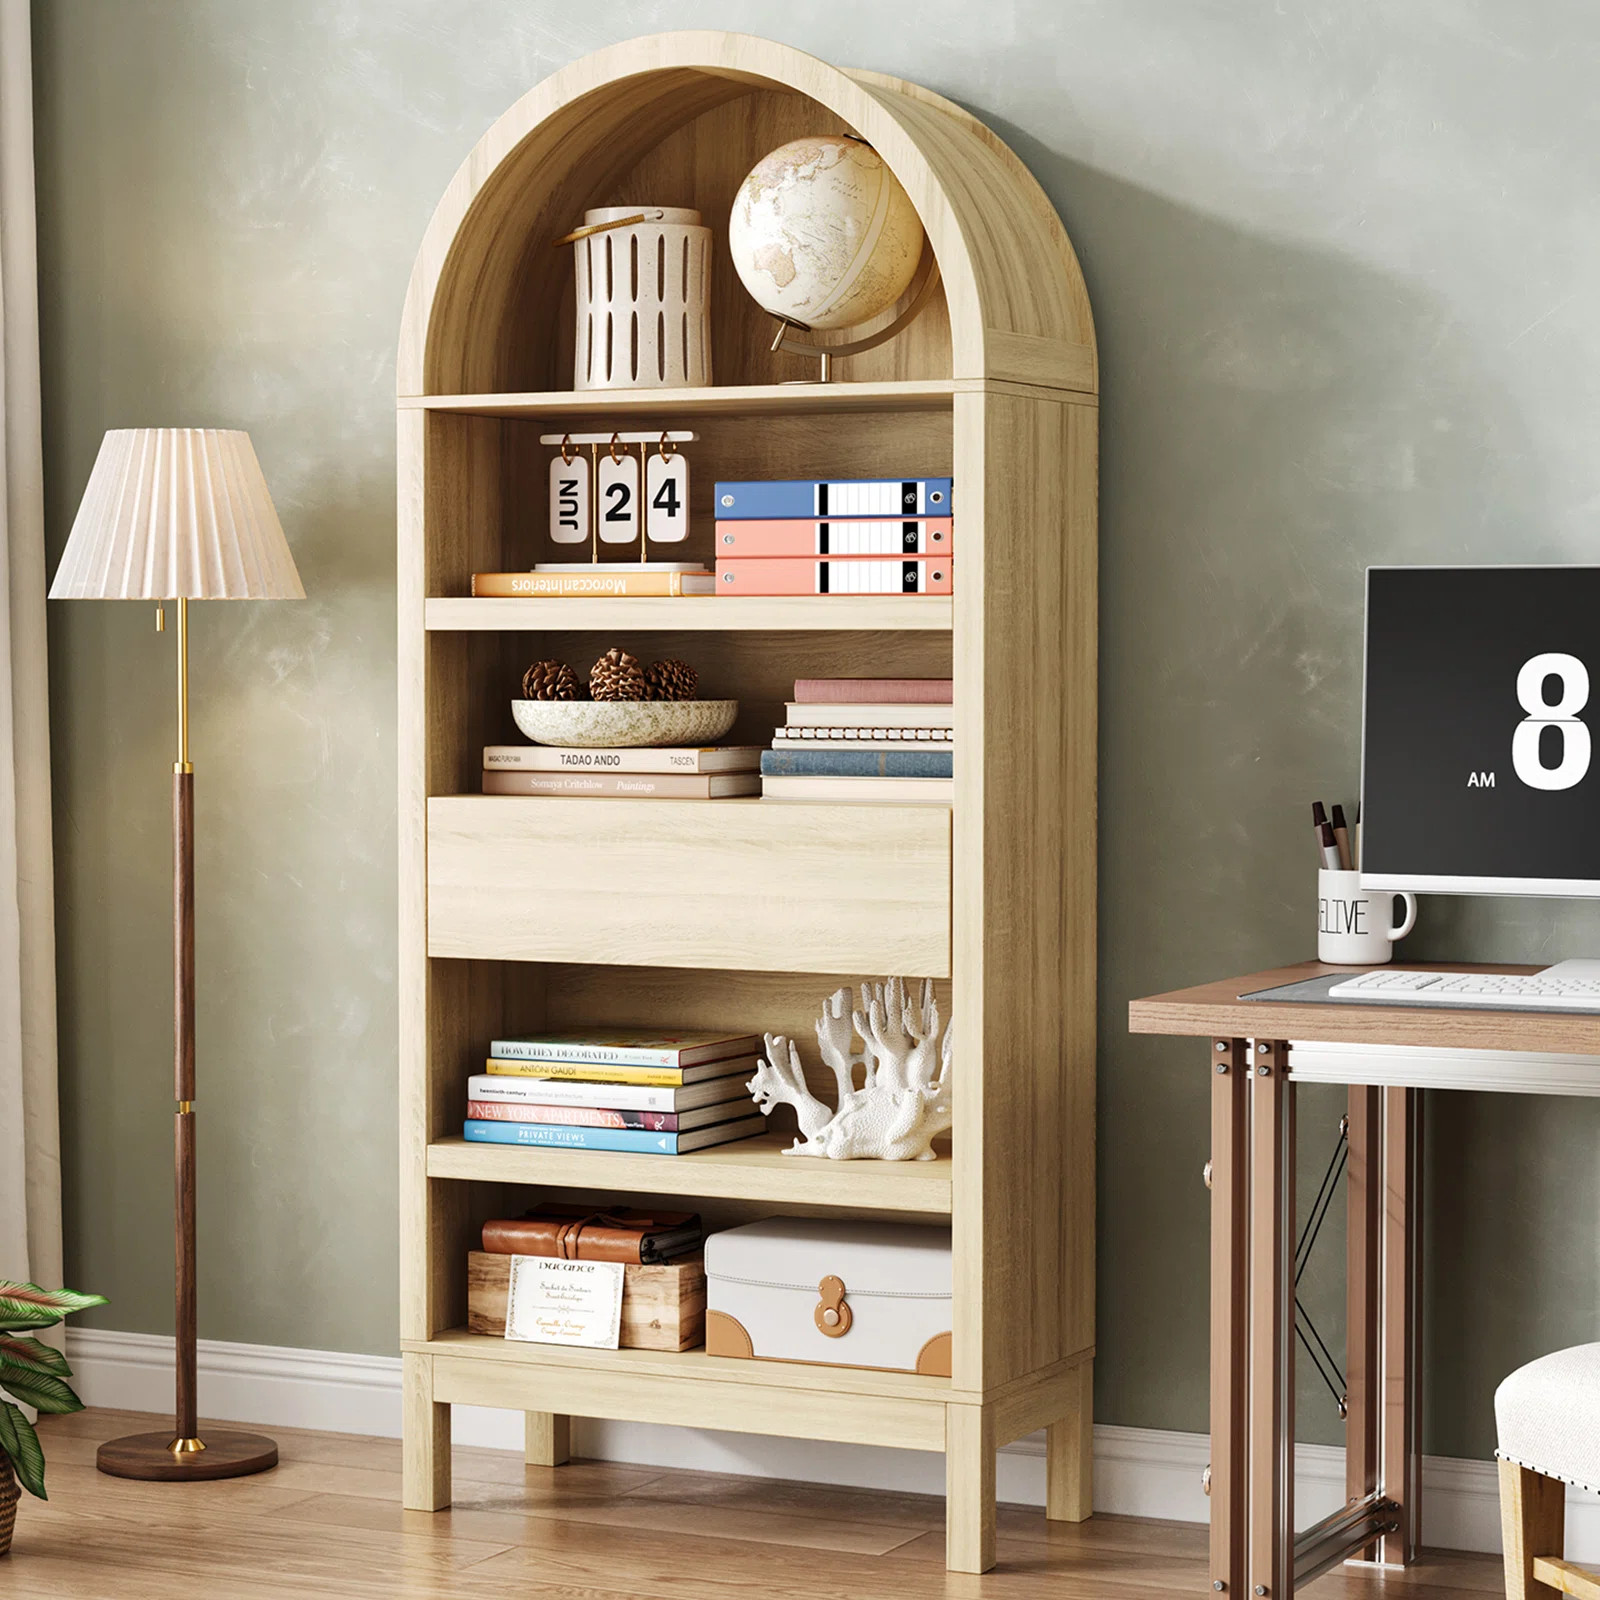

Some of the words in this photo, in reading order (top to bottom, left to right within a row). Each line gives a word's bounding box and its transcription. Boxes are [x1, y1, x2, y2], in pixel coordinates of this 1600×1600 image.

[559, 479, 579, 530] JUN
[605, 482, 632, 522] 2
[653, 478, 681, 518] 4
[1467, 772, 1496, 788] AM
[1511, 652, 1592, 791] 8
[560, 754, 592, 766] TADAO
[594, 755, 621, 766] ANDO
[530, 778, 562, 791] Somaya
[564, 779, 603, 790] Critchlow
[616, 780, 656, 794] Paintings
[501, 1046, 524, 1056] HOW
[528, 1047, 553, 1058] THEY
[557, 1049, 619, 1061] DECORATED
[520, 1064, 550, 1074] ANTONI
[475, 1103, 503, 1119] NEW
[506, 1105, 538, 1121] YORK
[543, 1108, 620, 1127] APARTMENTS
[518, 1129, 554, 1141] PRIVATE
[556, 1132, 585, 1143] VIEWS
